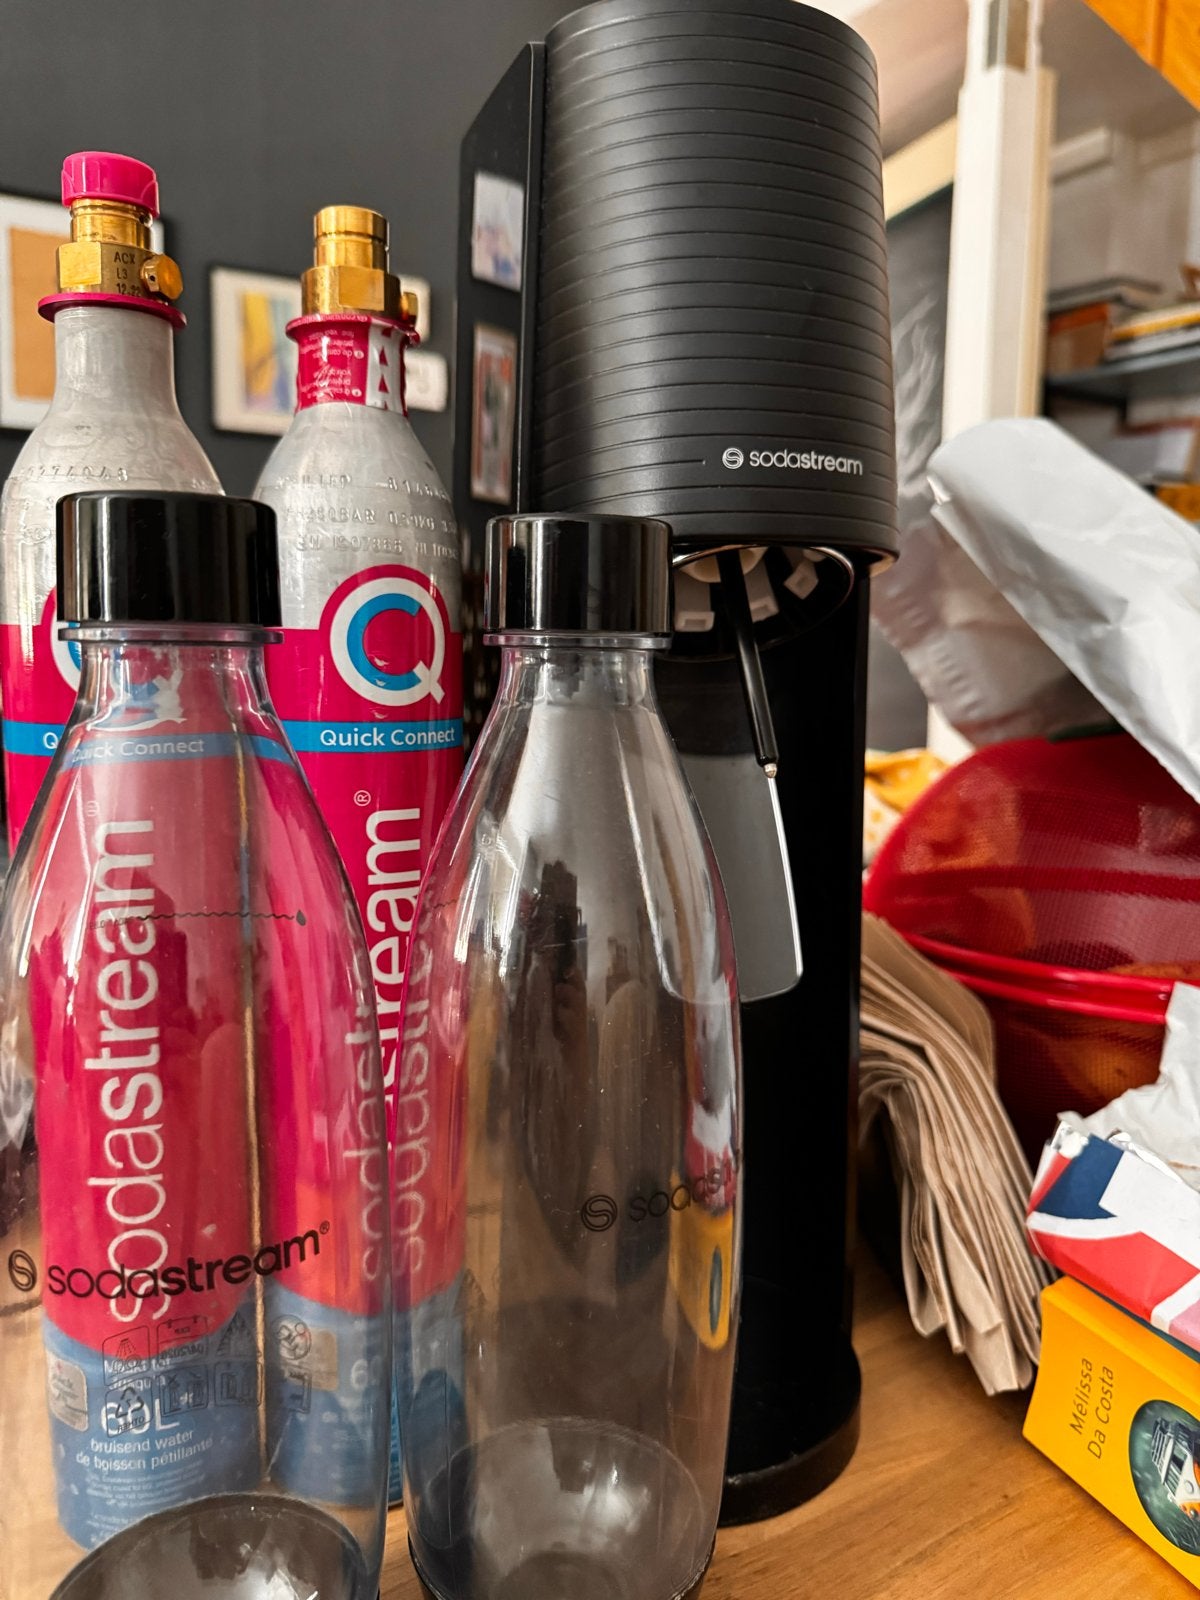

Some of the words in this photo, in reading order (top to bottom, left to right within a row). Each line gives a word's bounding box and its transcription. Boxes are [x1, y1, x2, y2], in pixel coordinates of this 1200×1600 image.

[113, 251, 136, 265] ACX
[116, 267, 128, 280] L3
[749, 449, 864, 476] sodastream
[119, 739, 205, 757] Connect
[320, 727, 385, 746] Quick
[391, 728, 455, 746] Connect
[85, 820, 170, 1323] sodastream
[1069, 1358, 1093, 1435] Mélissa
[1095, 1365, 1114, 1424] Costa
[90, 1437, 150, 1454] bruisend
[155, 1430, 194, 1450] water
[93, 1455, 146, 1473] boisson
[151, 1436, 214, 1470] pétillante
[1087, 1429, 1106, 1460] Da
